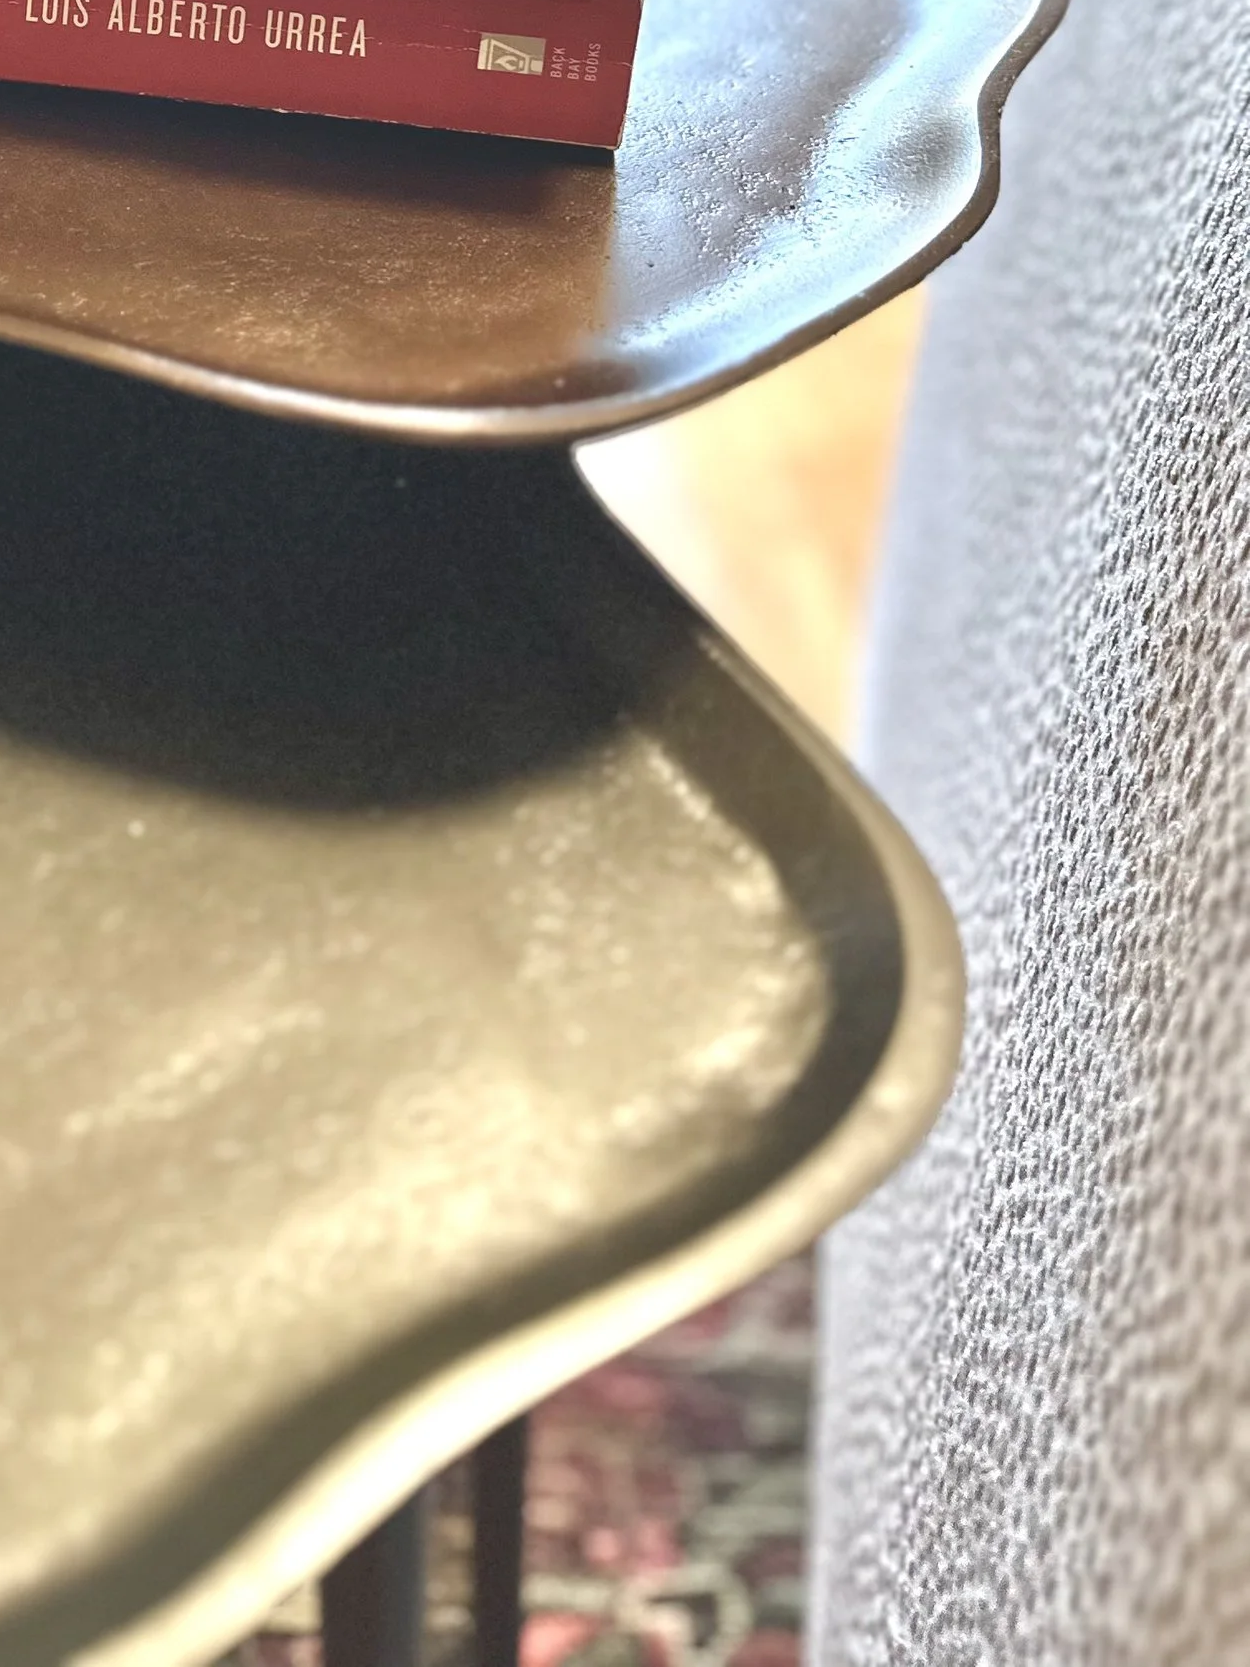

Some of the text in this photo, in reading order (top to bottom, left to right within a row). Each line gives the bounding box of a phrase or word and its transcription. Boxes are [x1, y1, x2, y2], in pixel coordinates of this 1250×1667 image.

[264, 9, 368, 58] URREA
[550, 46, 566, 79] BACK
[567, 57, 581, 80] BAY
[584, 42, 601, 82] BOOKS
